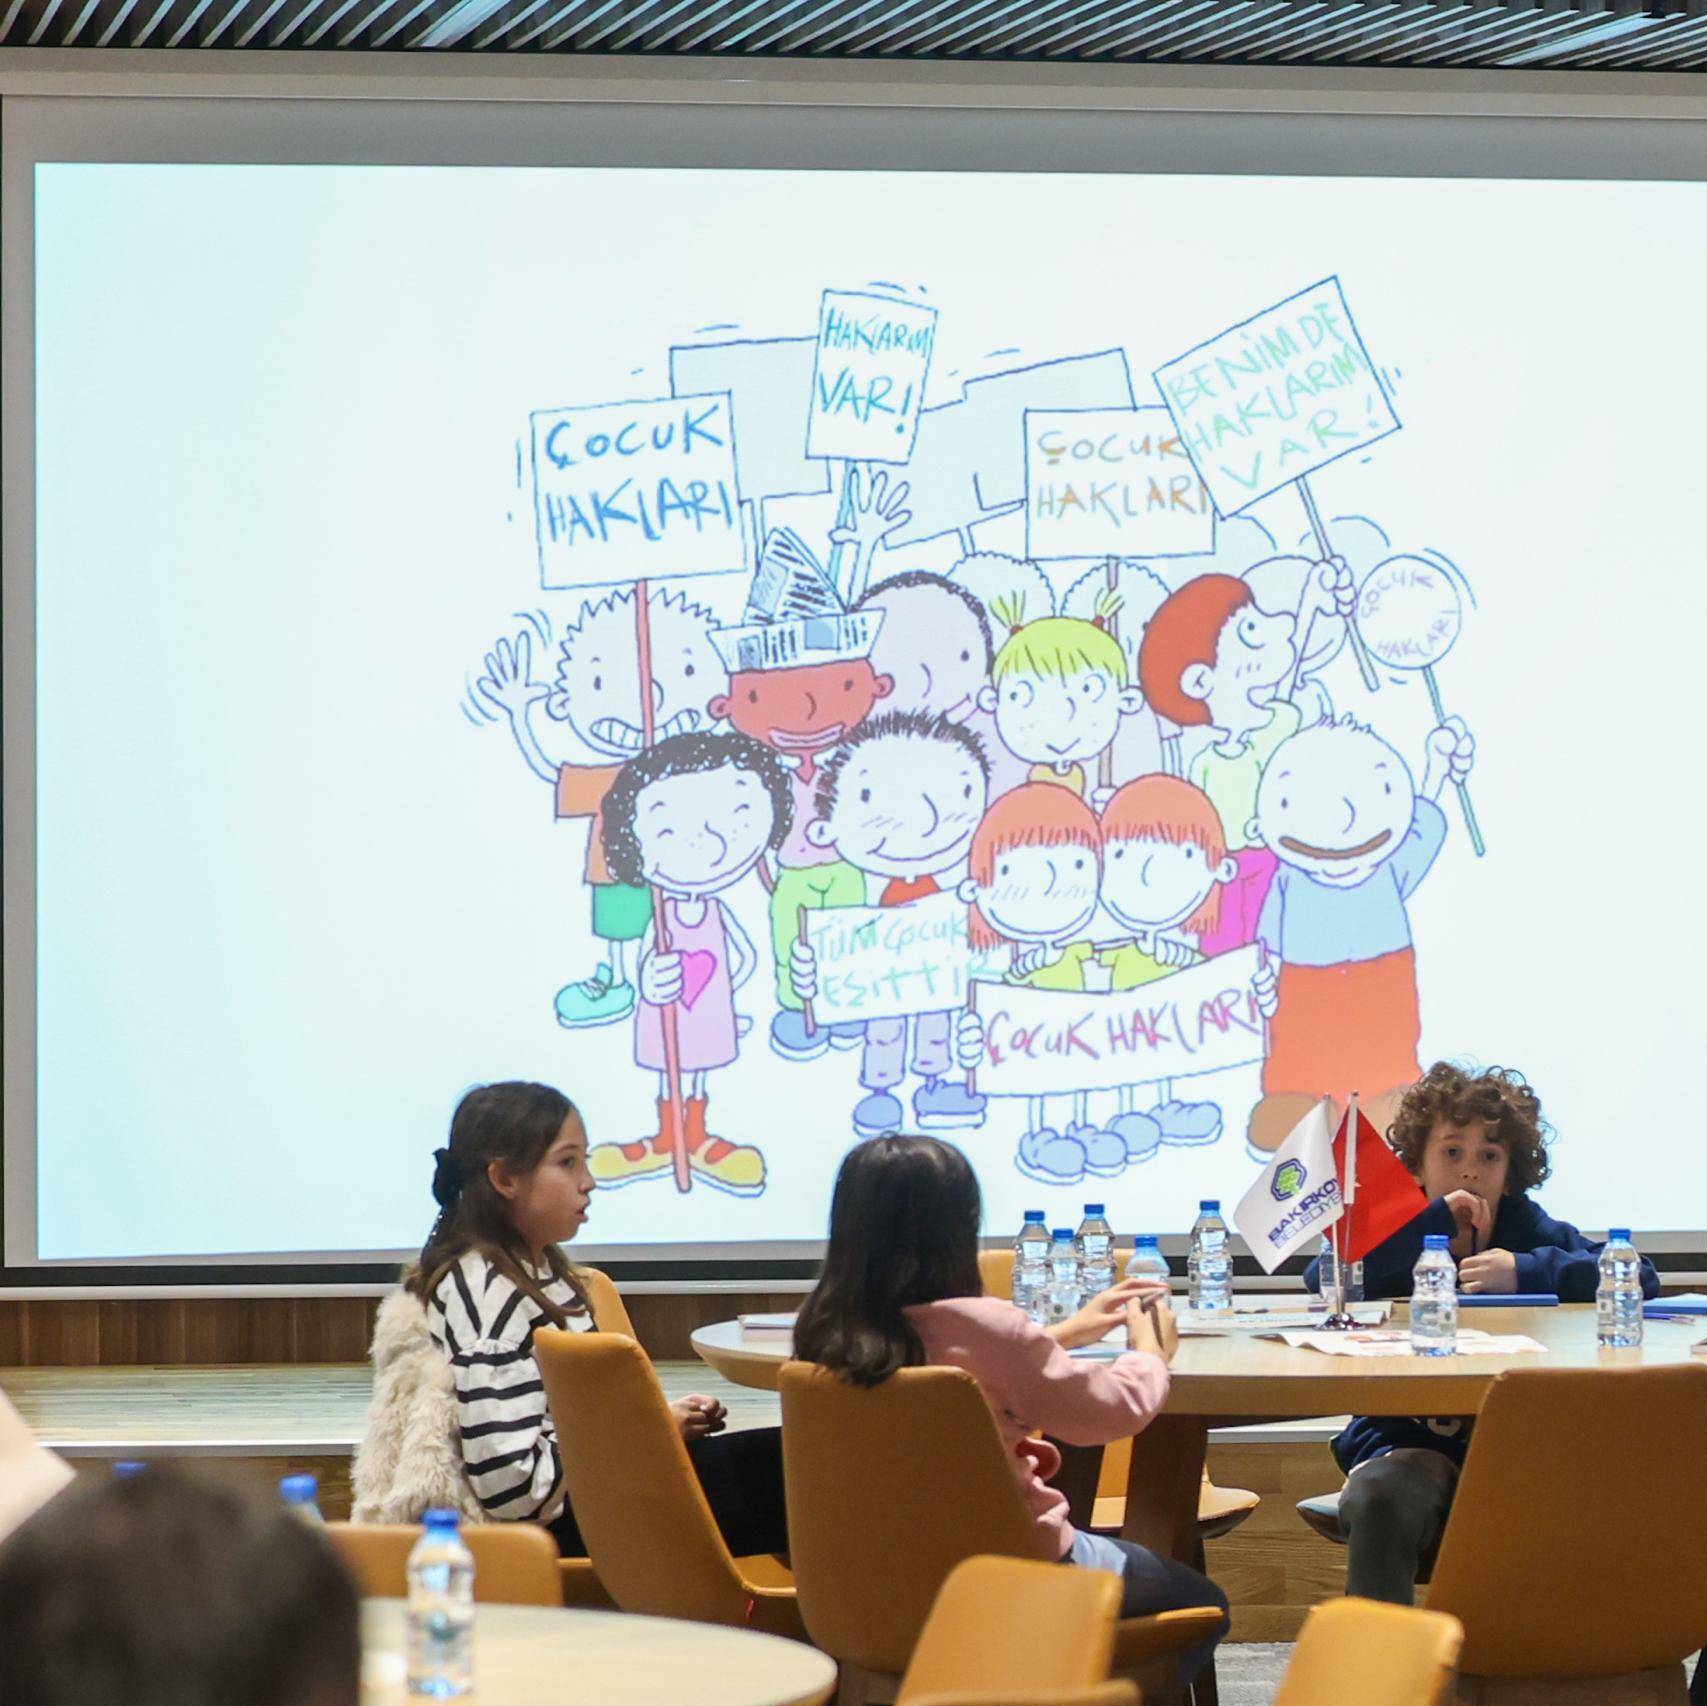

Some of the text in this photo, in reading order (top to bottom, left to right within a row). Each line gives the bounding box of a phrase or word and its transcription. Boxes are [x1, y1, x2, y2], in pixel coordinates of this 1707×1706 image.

[819, 367, 912, 434] VAR!
[1184, 341, 1368, 463] HAKLARIM
[545, 404, 724, 470] ÇOCUK
[1038, 430, 1191, 465] ÇOCUK
[546, 477, 733, 546] HAKLARI
[1037, 475, 1207, 528] HAKLARI
[884, 902, 969, 955] ÇOCUK
[986, 989, 1262, 1067] ÇOCUK HAKLARI
